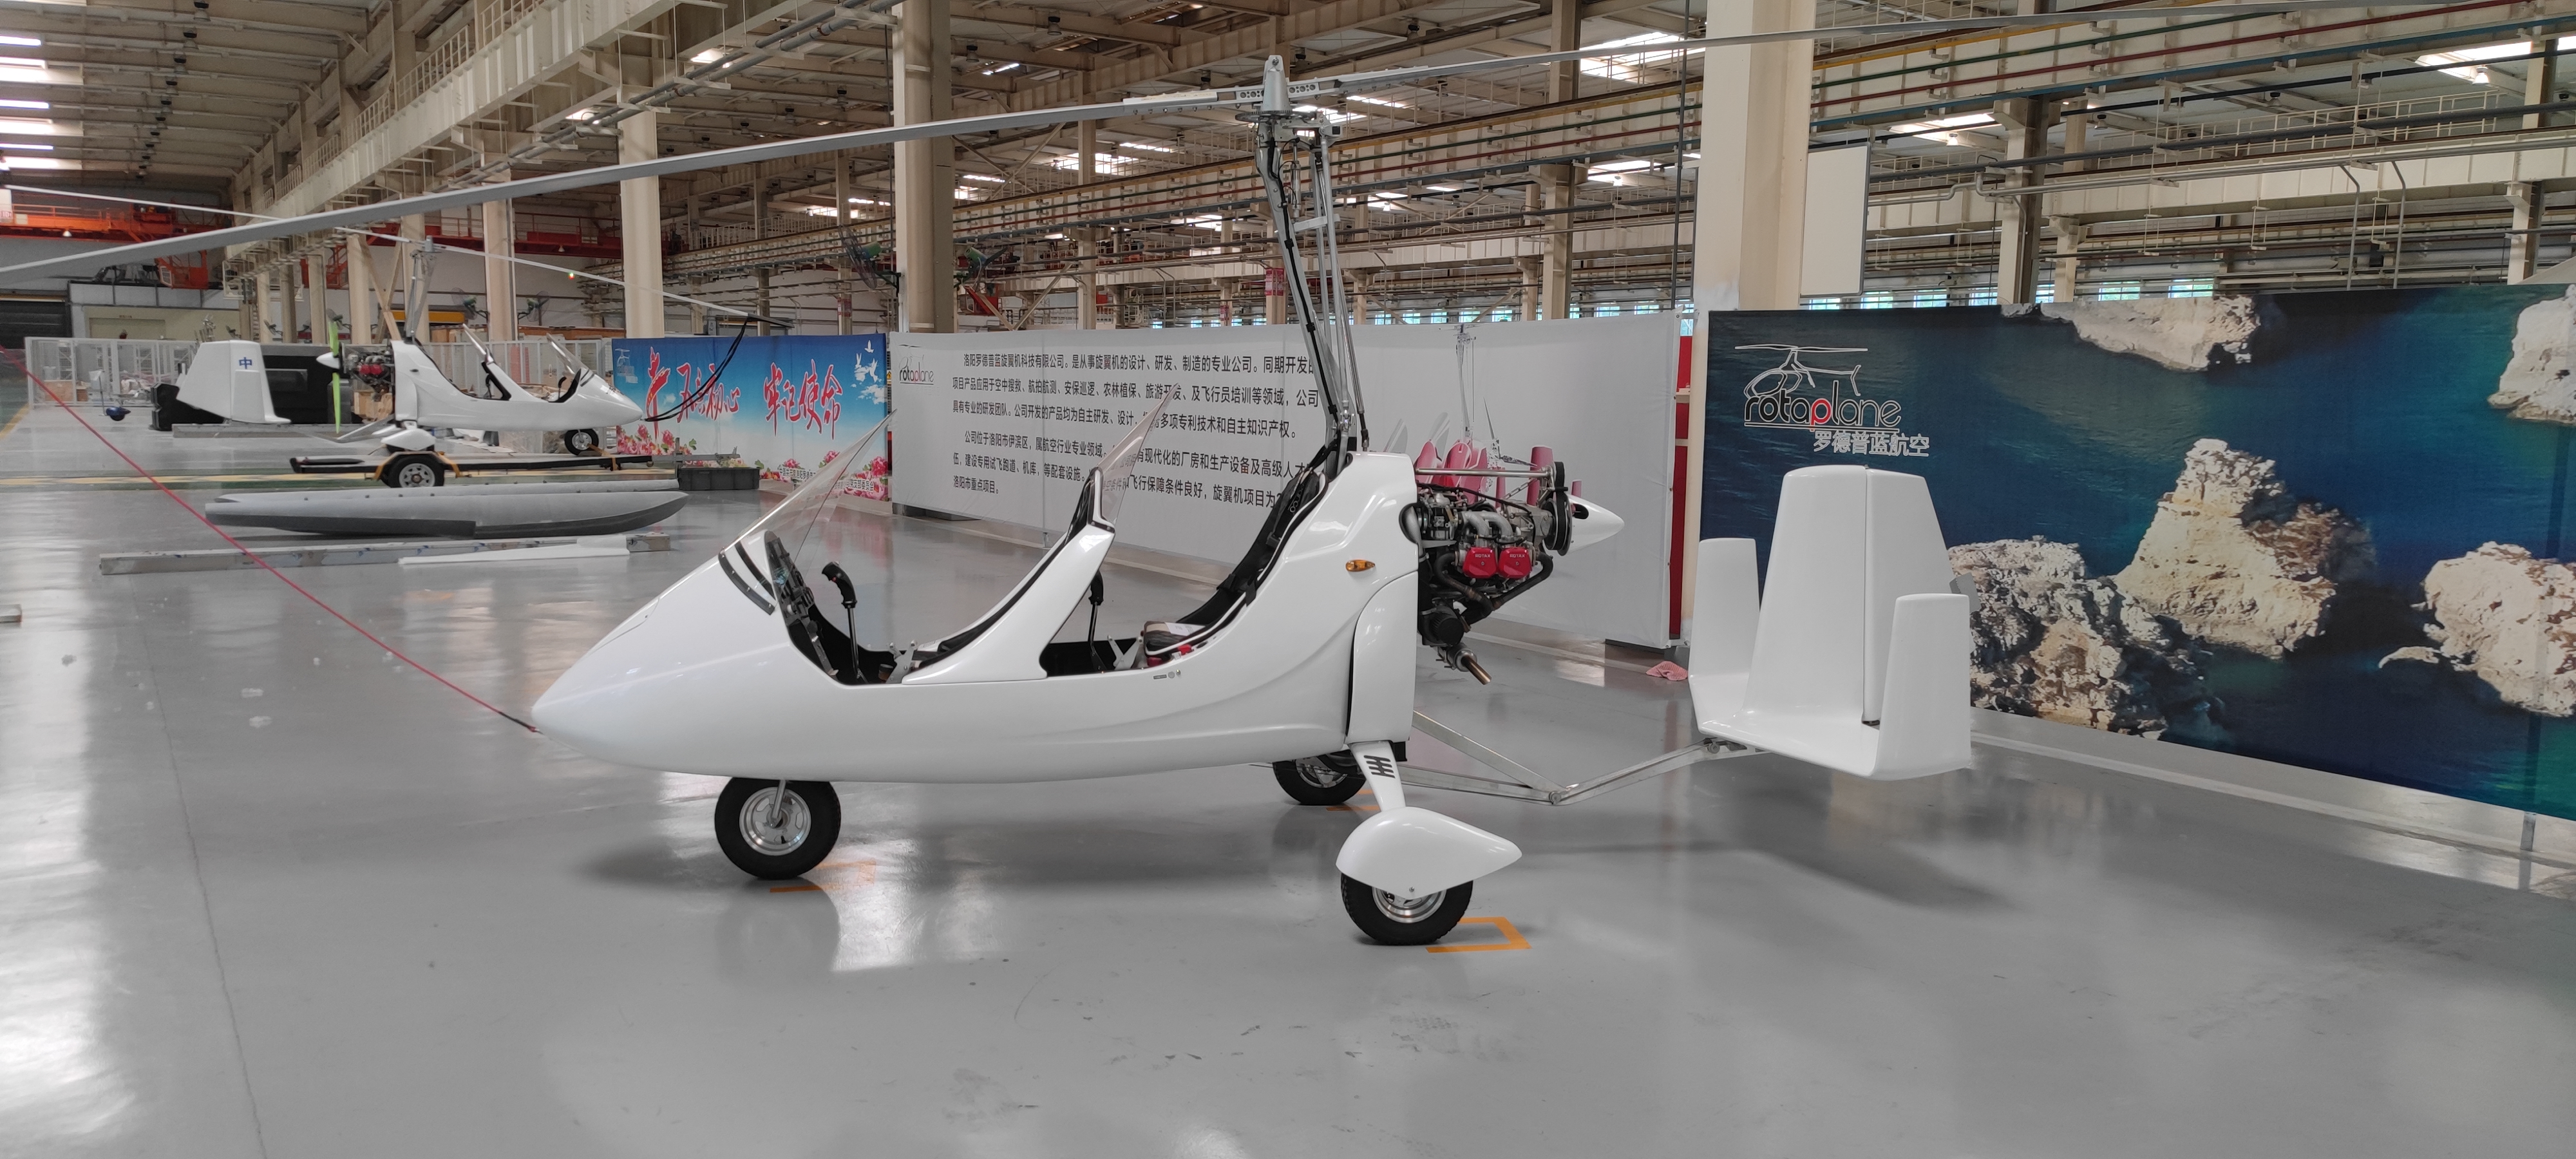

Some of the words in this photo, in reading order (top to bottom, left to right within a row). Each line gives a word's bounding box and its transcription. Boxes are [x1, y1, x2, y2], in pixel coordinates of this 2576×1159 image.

[1744, 380, 1901, 431] rotaplane
[1814, 430, 1929, 457] 罗德普蓝航空
